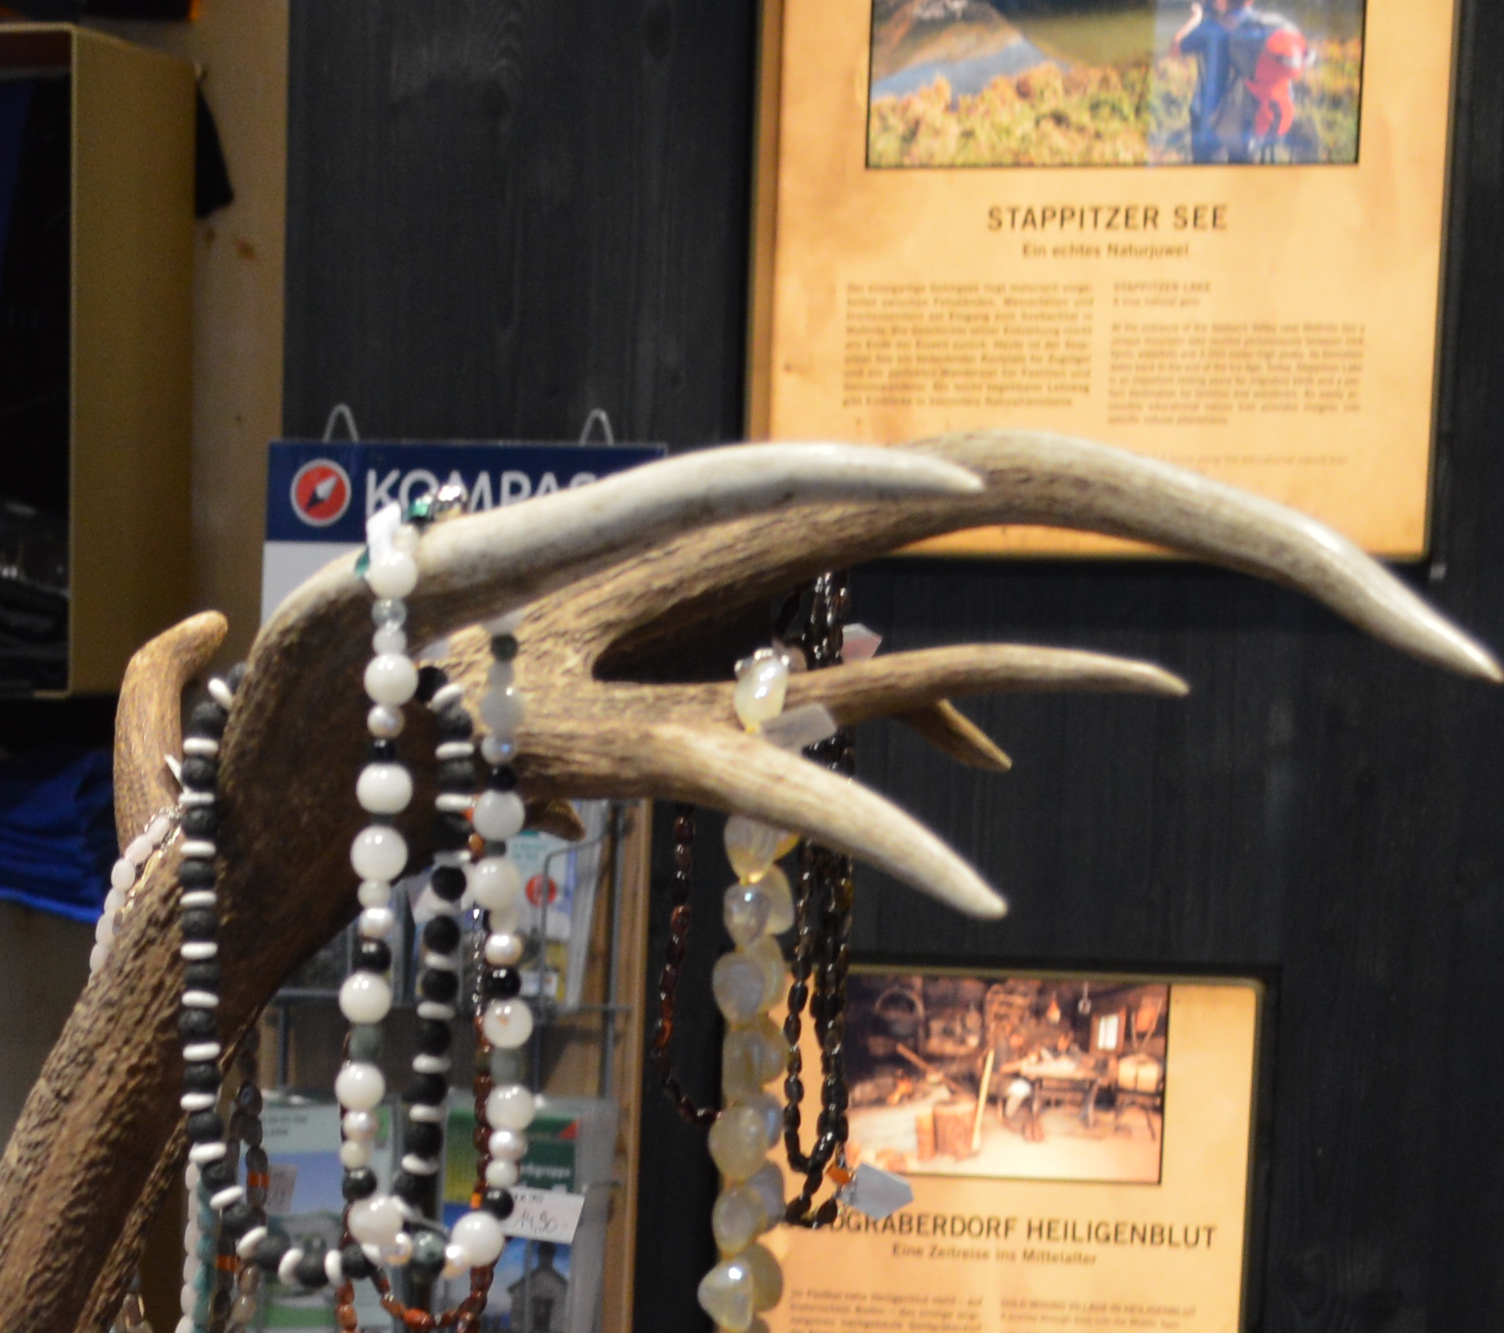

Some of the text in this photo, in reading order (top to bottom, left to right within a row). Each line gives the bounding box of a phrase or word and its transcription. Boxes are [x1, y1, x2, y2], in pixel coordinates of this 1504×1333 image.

[987, 204, 1228, 231] STAPPITZER SEE
[1023, 243, 1189, 261] Ein echtes Naturjuwel
[1027, 1217, 1217, 1249] HEILIGENBLUT
[892, 1244, 1097, 1267] Eine Zeitreise ins Mittelalter
